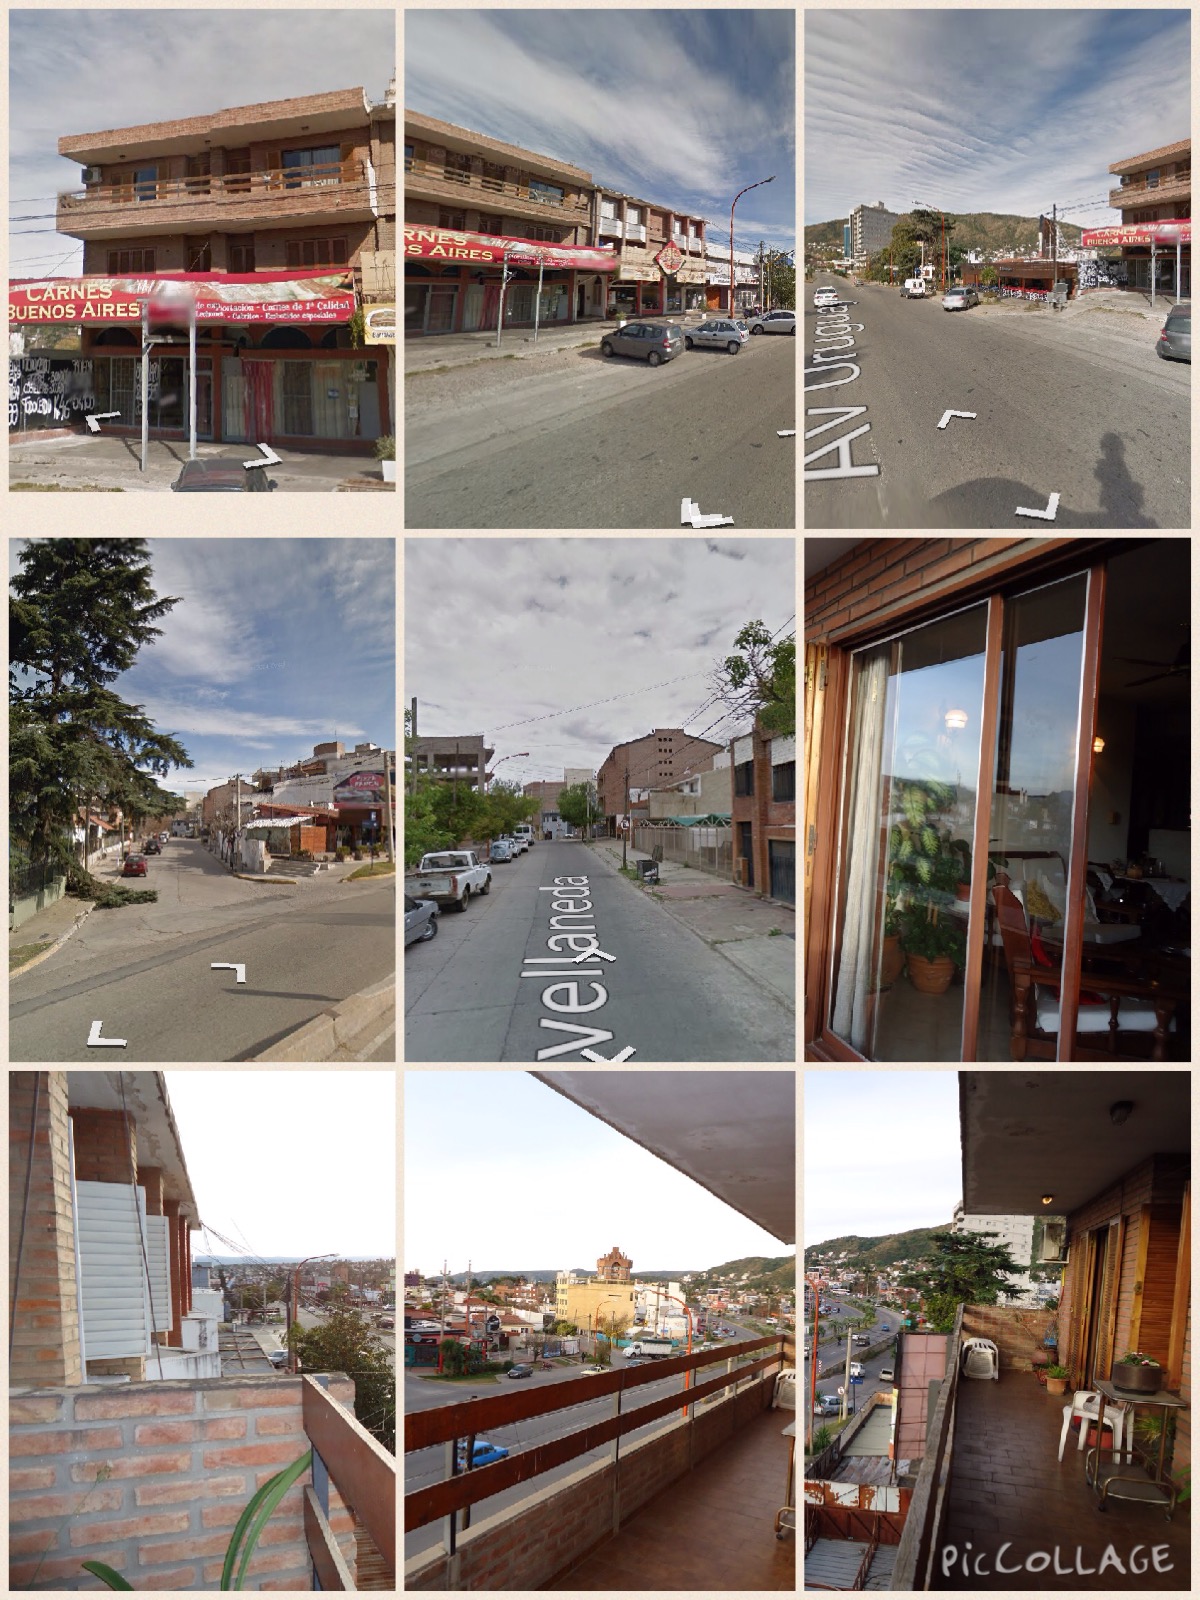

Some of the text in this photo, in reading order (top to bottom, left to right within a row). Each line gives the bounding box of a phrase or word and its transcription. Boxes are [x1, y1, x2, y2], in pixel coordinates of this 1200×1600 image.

[1096, 226, 1138, 238] CARNES
[1121, 234, 1152, 245] AIRES
[429, 244, 493, 261] AIRES
[26, 283, 113, 301] CARNES
[80, 301, 140, 318] AIRES
